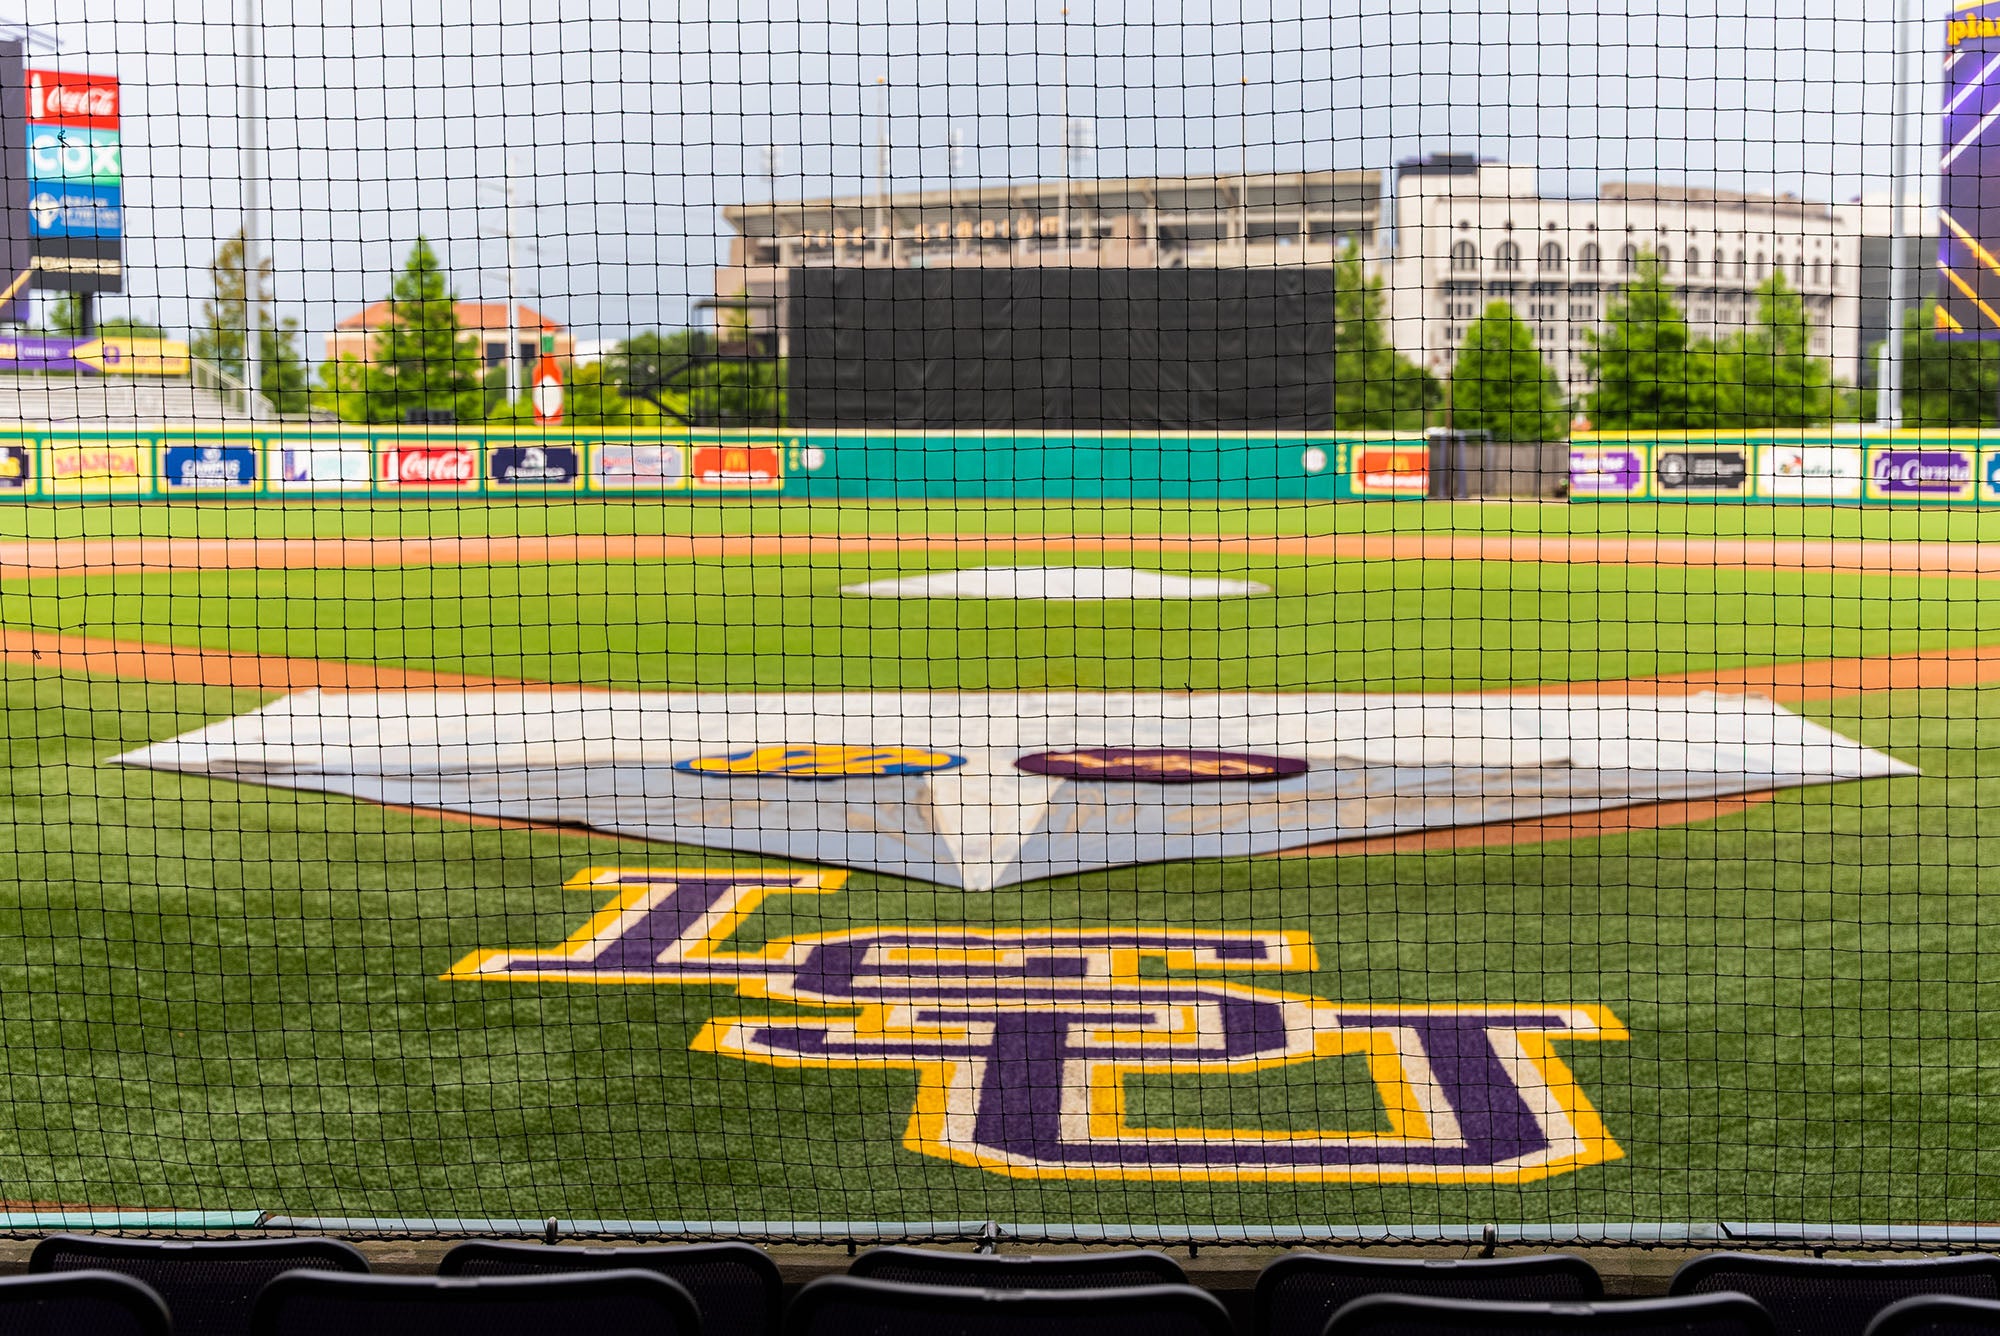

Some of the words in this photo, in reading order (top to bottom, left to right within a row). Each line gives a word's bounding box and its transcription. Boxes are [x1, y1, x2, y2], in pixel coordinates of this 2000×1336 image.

[1946, 12, 2000, 46] pla
[29, 135, 120, 174] COX
[439, 866, 1630, 1185] LSU
